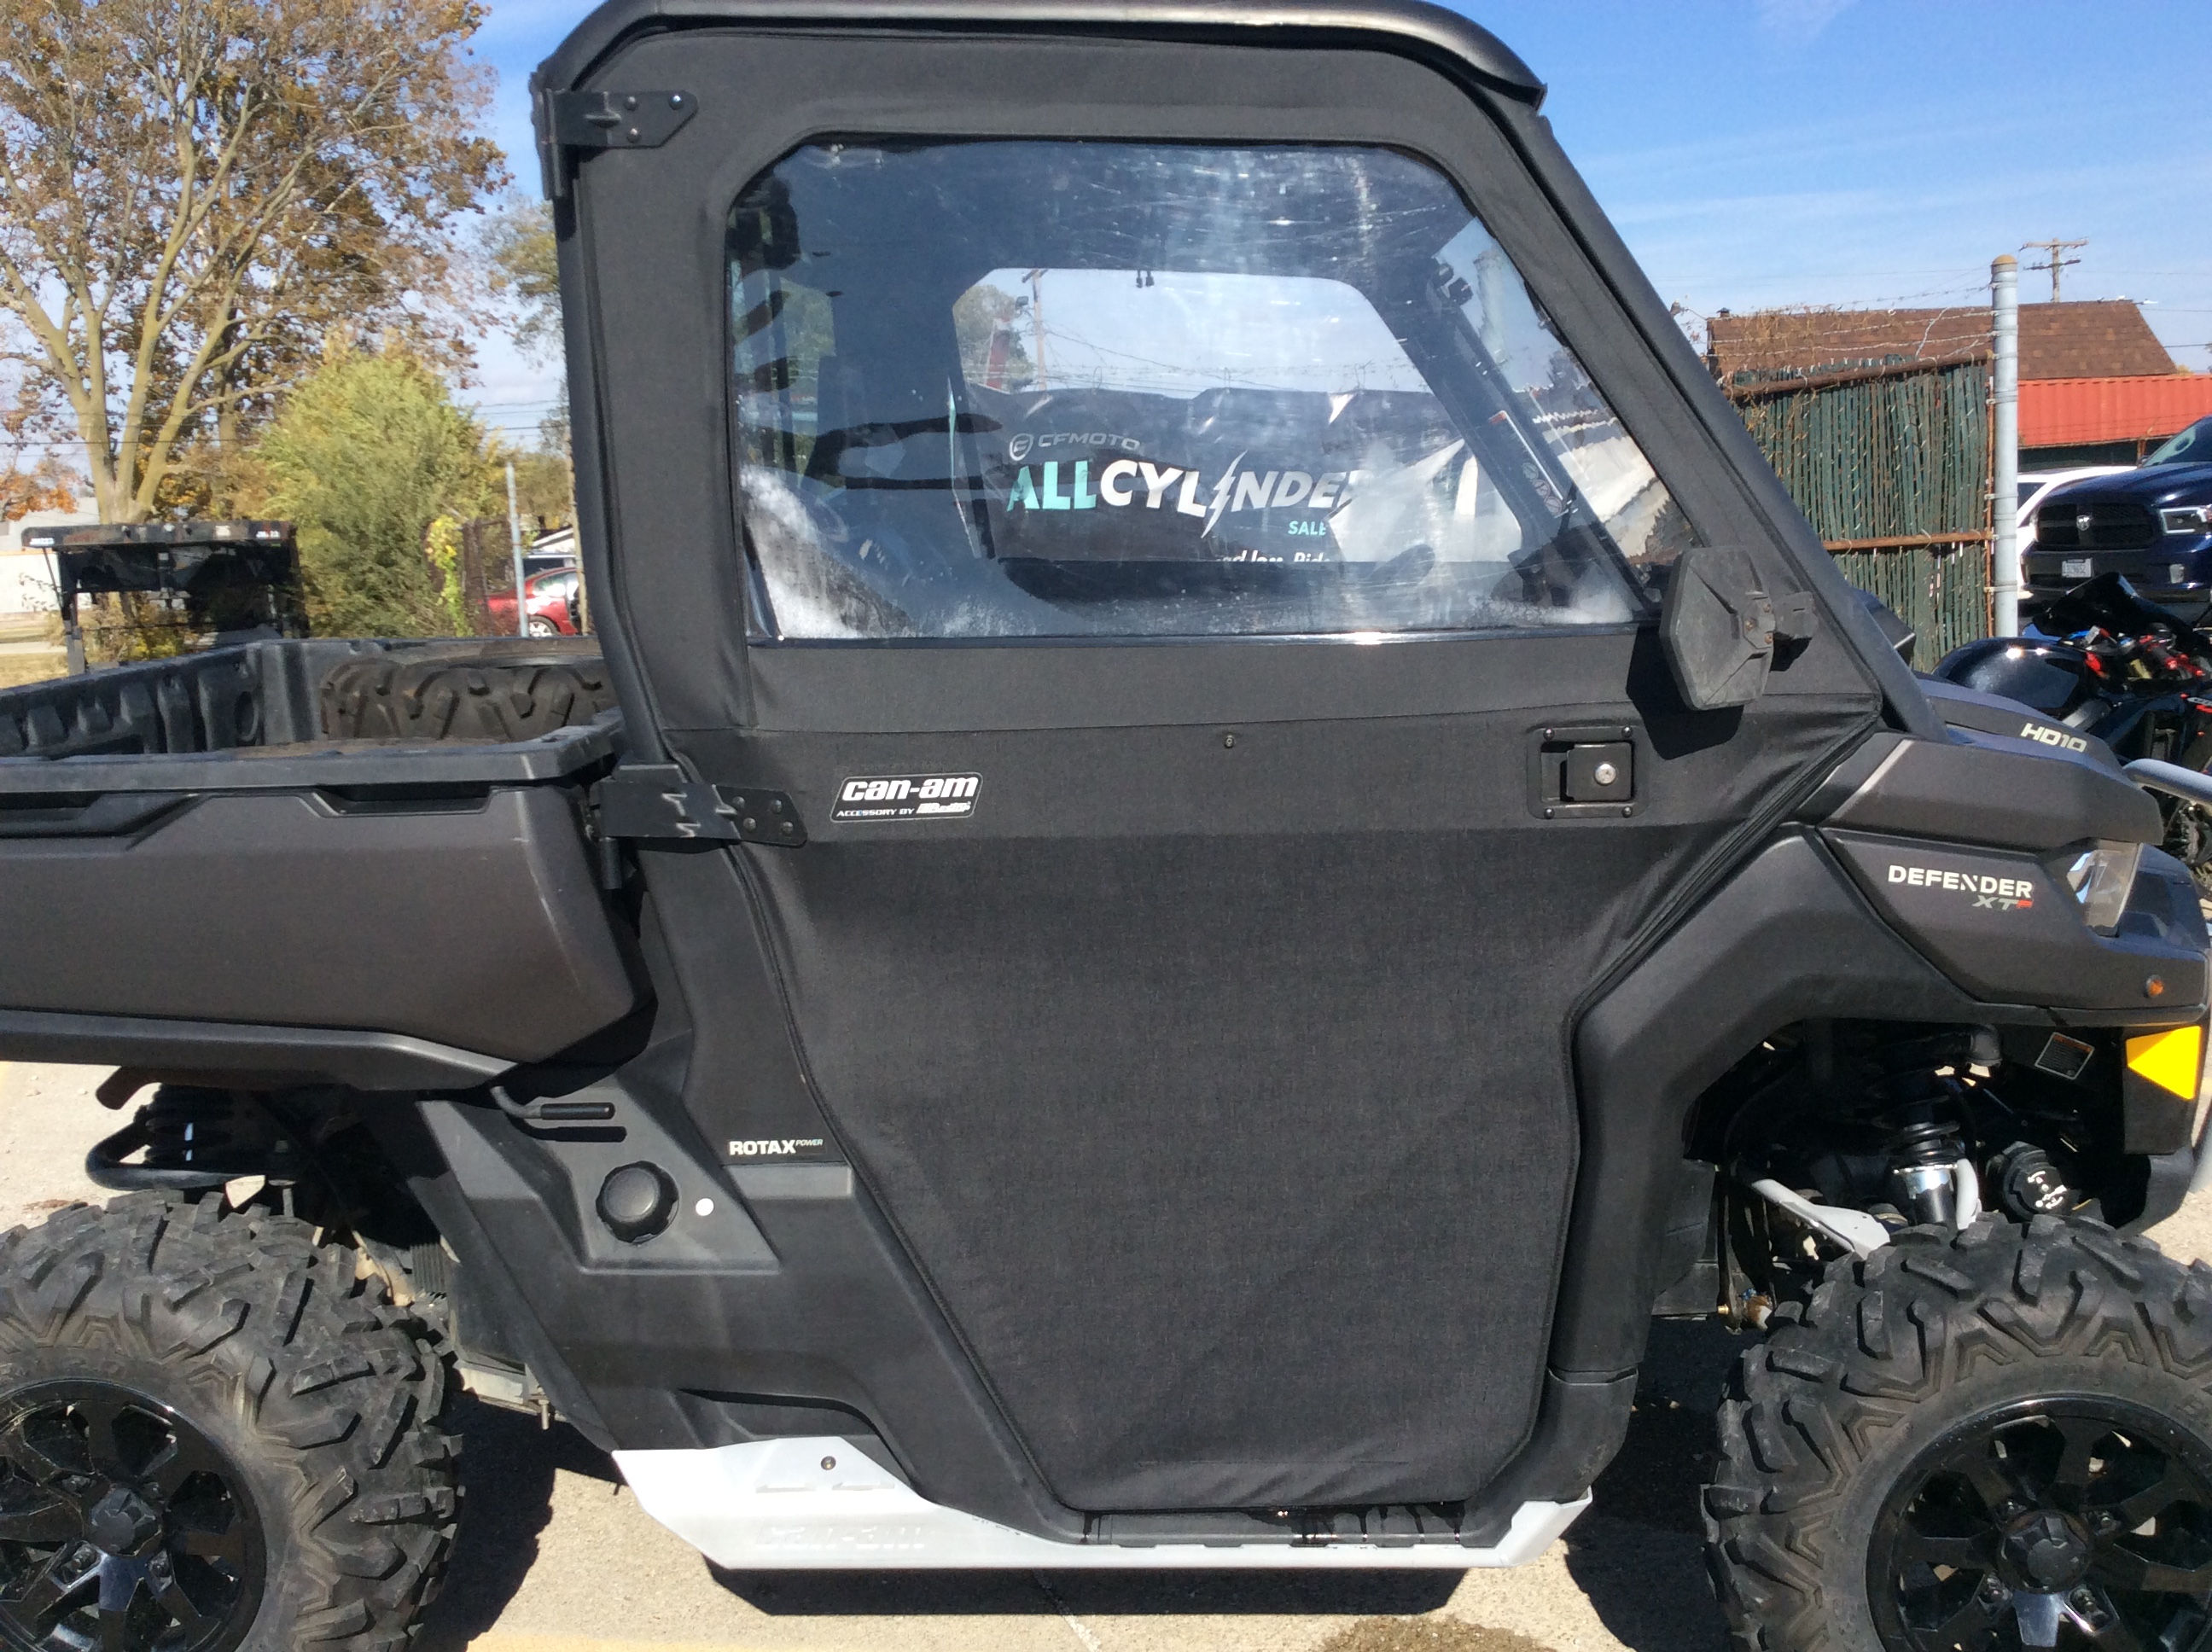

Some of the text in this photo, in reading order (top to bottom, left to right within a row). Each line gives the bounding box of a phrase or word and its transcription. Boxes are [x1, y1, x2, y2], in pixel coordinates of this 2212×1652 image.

[1038, 433, 1141, 451] CFMOTO
[2020, 723, 2087, 753] HD10
[841, 777, 979, 801] can-am
[1888, 864, 2034, 899] DEFENDER
[730, 1140, 796, 1155] ROTAX
